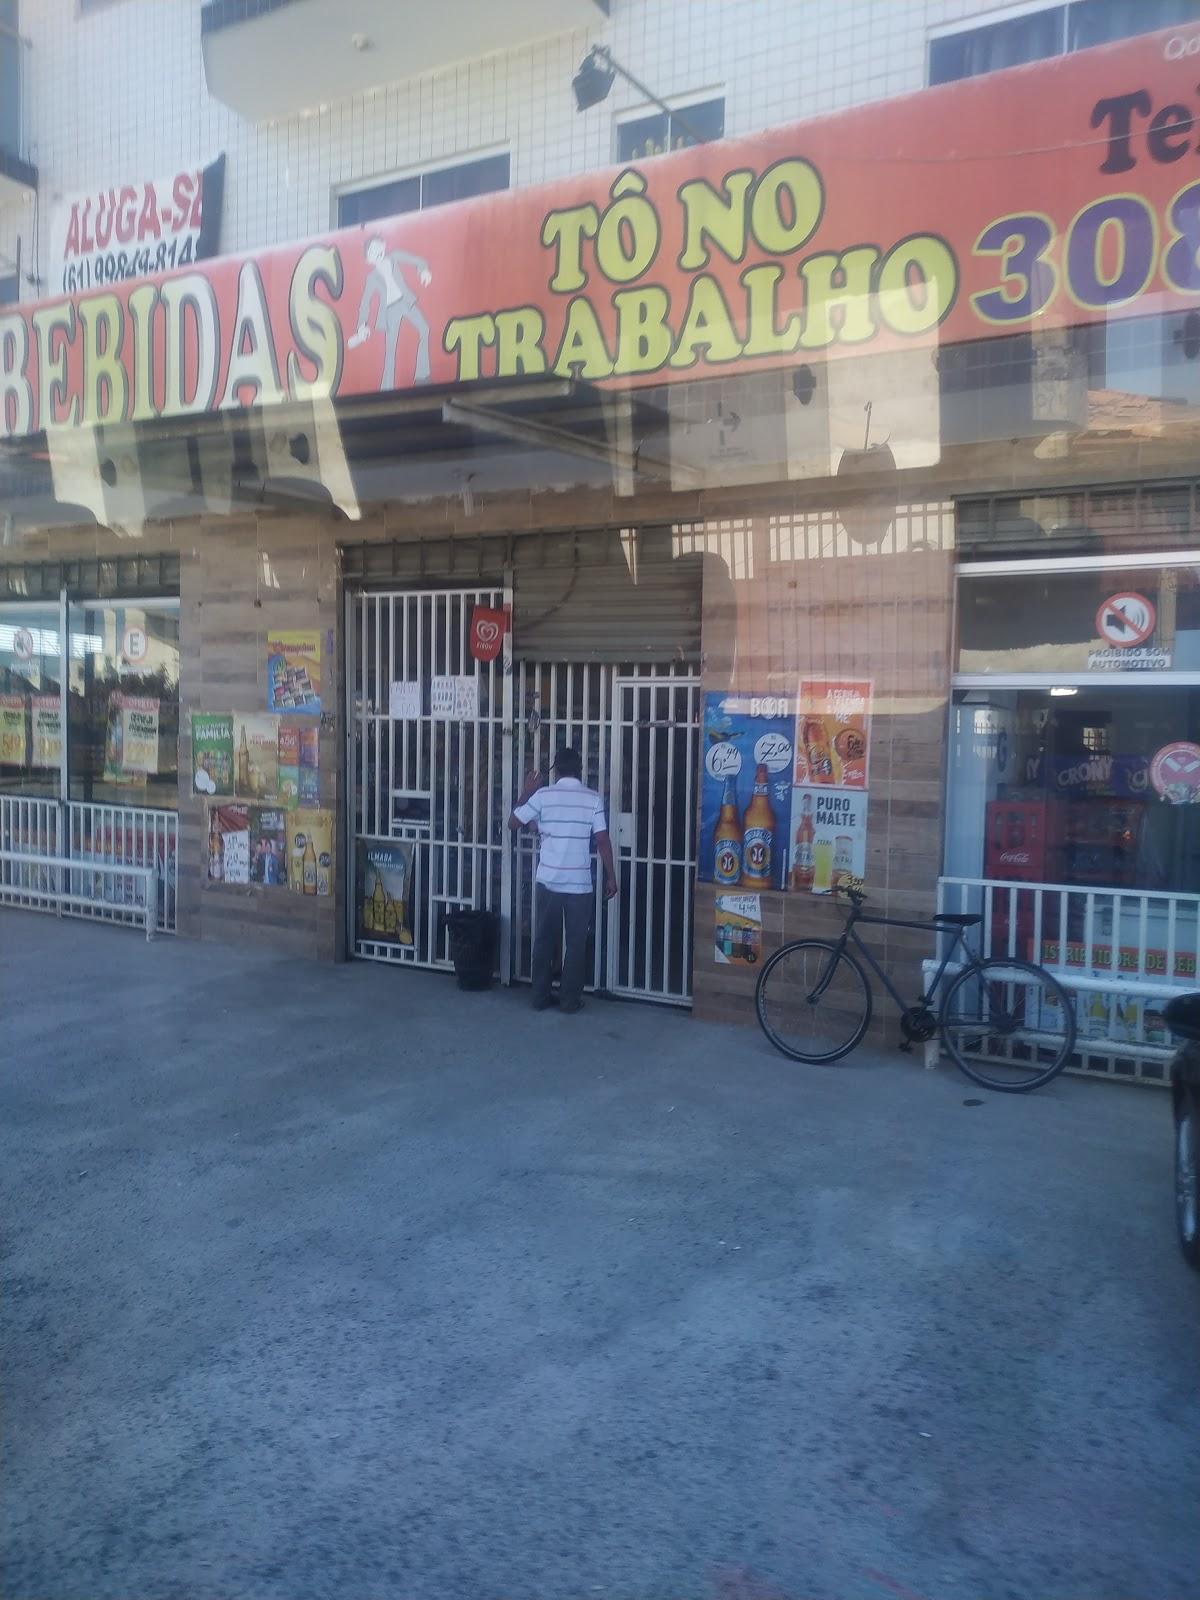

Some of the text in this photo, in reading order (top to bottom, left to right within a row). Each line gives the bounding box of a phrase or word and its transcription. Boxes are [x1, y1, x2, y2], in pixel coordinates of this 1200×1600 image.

[1089, 84, 1200, 175] Te
[541, 157, 826, 294] TÔ NO
[444, 232, 960, 382] TRABALHO
[0, 243, 344, 437] BEBIDAS
[1091, 659, 1166, 669] AUTOMOTIVO
[1057, 757, 1114, 788] CRONY
[816, 812, 856, 827] MALTE
[817, 797, 850, 811] PURO
[1039, 943, 1140, 969] ISRIBIDR
